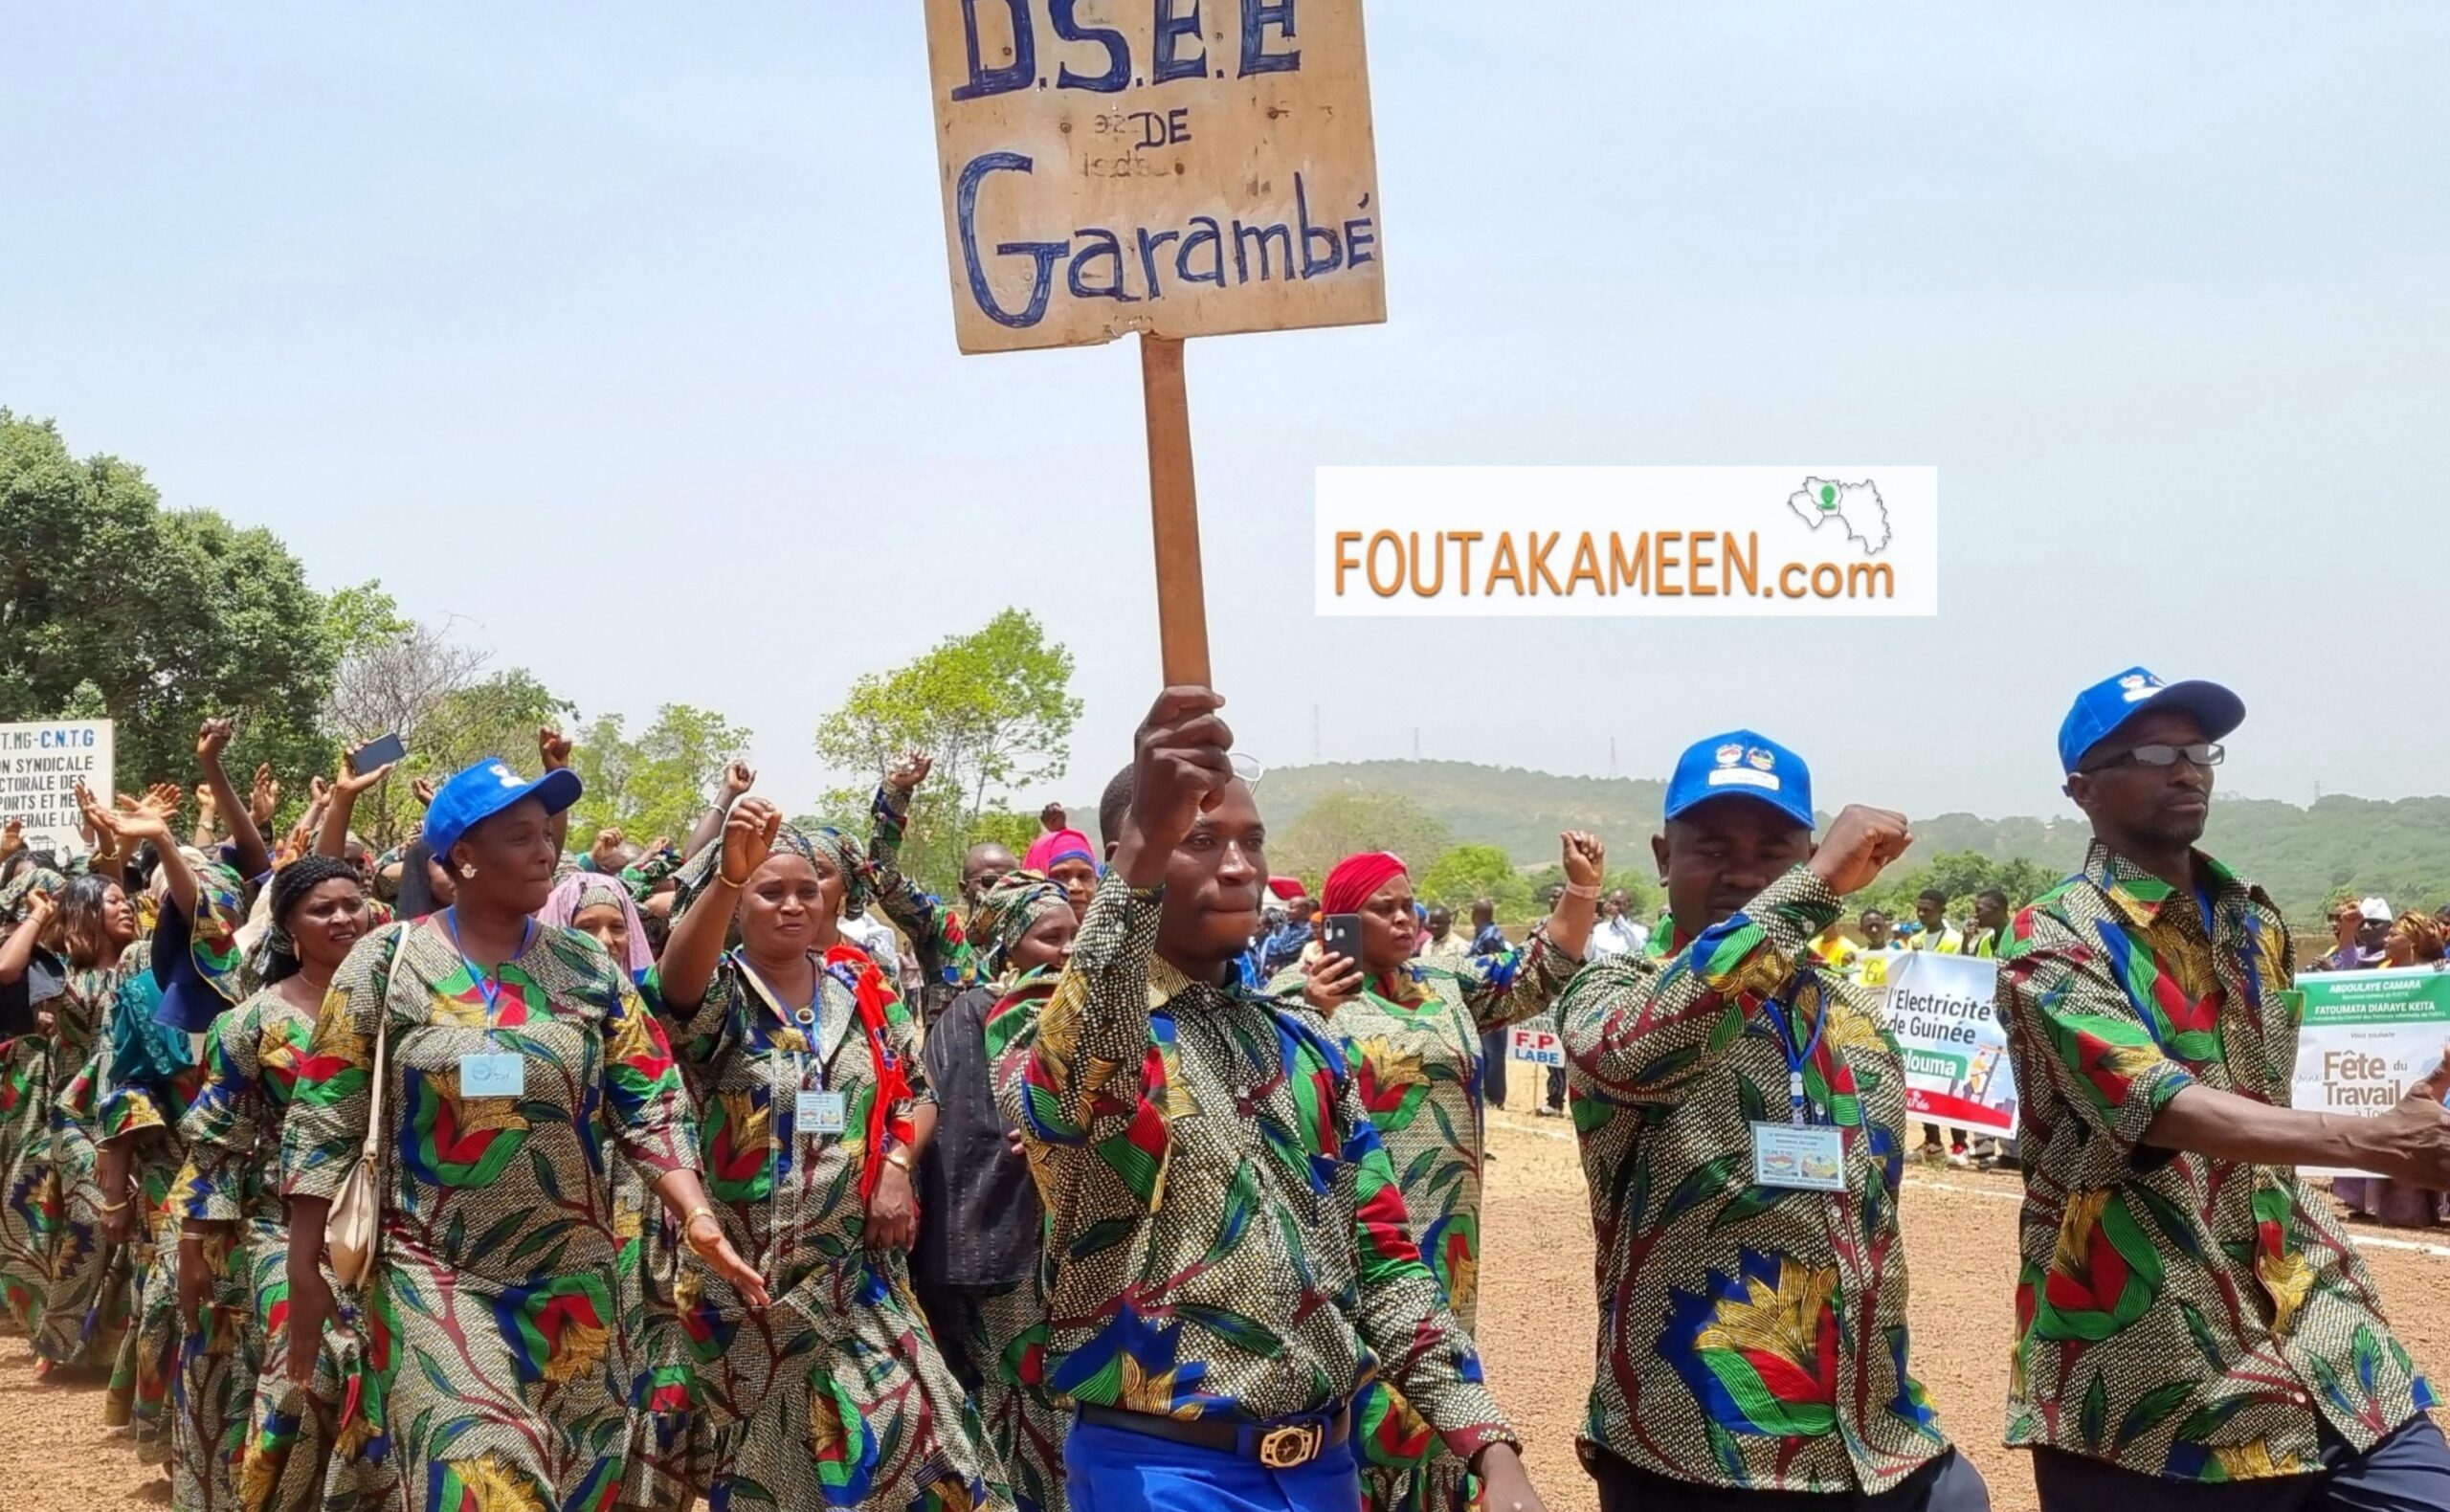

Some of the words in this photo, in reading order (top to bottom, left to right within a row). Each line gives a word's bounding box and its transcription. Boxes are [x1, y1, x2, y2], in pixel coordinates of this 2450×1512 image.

[1127, 107, 1192, 151] DE
[0, 758, 11, 774] N
[16, 756, 94, 773] SYNDICALE
[59, 774, 86, 790] DES
[40, 793, 56, 810] ET
[2329, 982, 2381, 993] ABDOULAYE
[2383, 980, 2421, 990] CAMARA
[1886, 987, 1992, 1021] l'Electricité
[2314, 1003, 2367, 1015] FATOUMATA
[2368, 1002, 2407, 1013] DIARAYE
[2408, 1001, 2436, 1012] KEITA
[1890, 1012, 1905, 1035] de
[1909, 1016, 1976, 1045] Guinée
[1516, 1033, 1554, 1050] F.P
[1515, 1048, 1559, 1064] LABE
[2324, 1049, 2386, 1080] Fête
[2393, 1059, 2408, 1071] du
[2323, 1078, 2401, 1106] Travail
